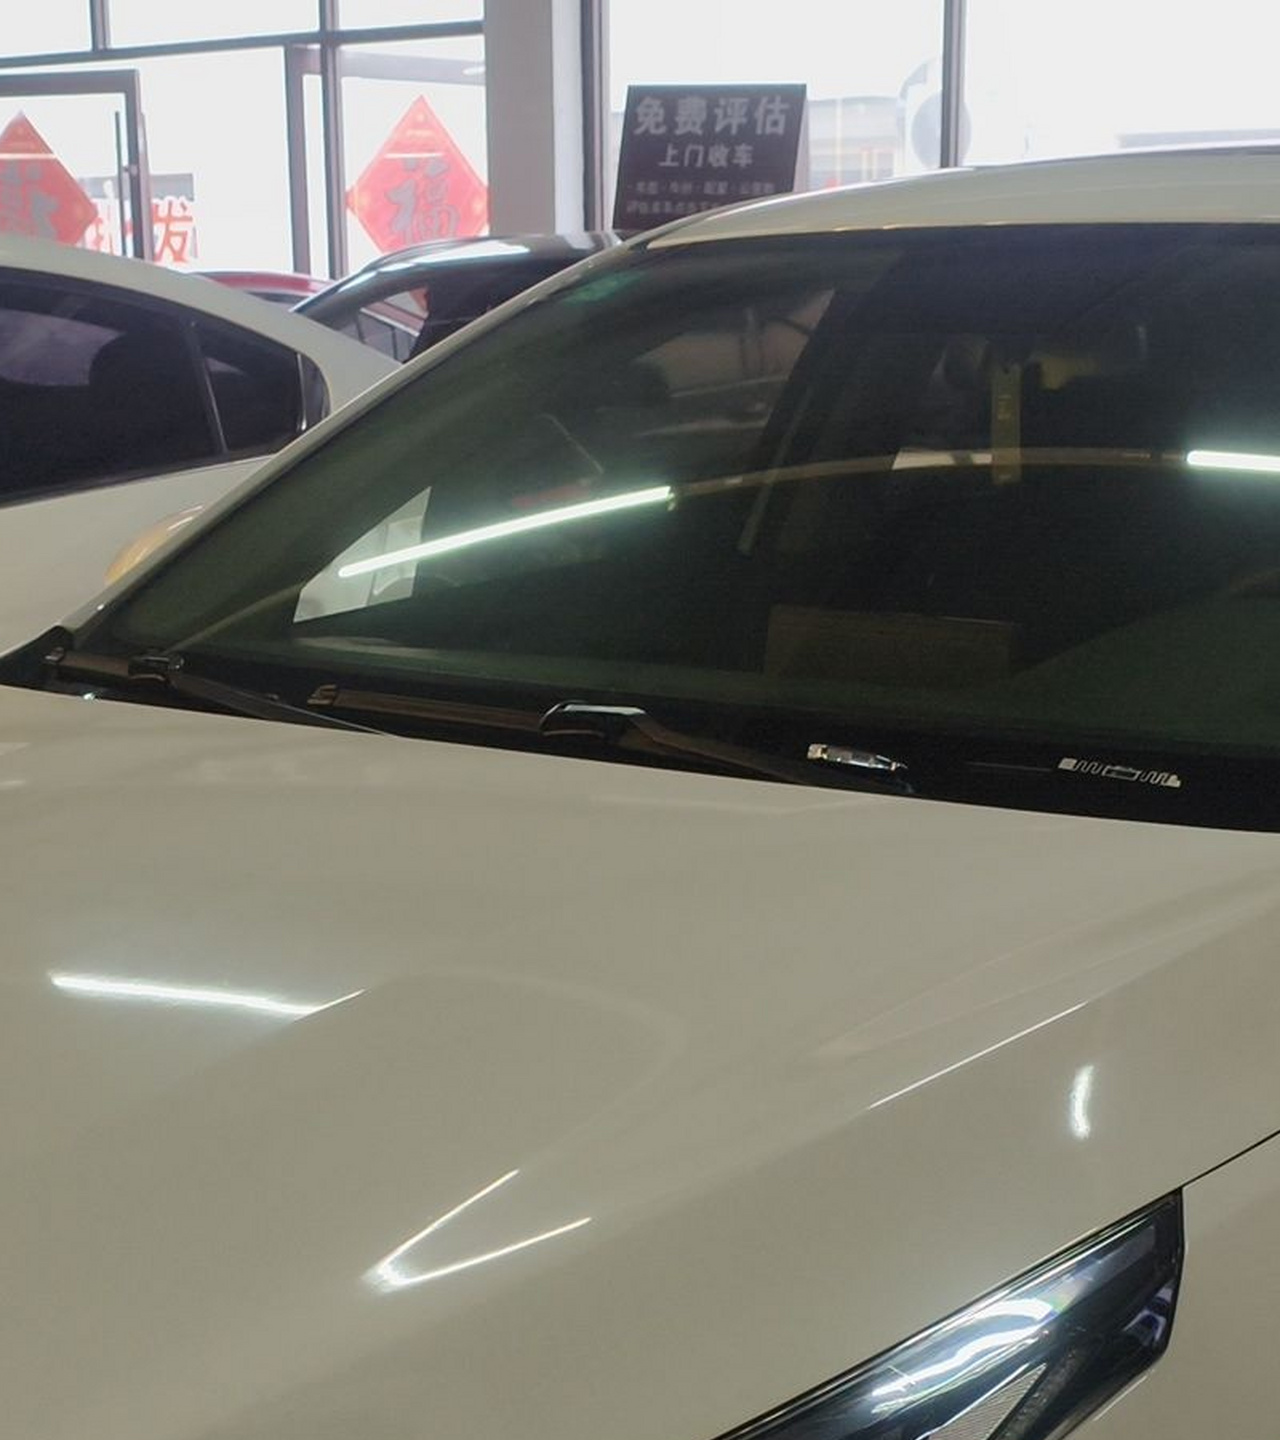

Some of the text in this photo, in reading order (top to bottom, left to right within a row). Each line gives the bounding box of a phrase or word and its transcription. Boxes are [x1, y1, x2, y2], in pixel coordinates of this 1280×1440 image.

[633, 95, 790, 136] 免费评估
[657, 143, 755, 169] 上门收车
[387, 157, 460, 244] 福
